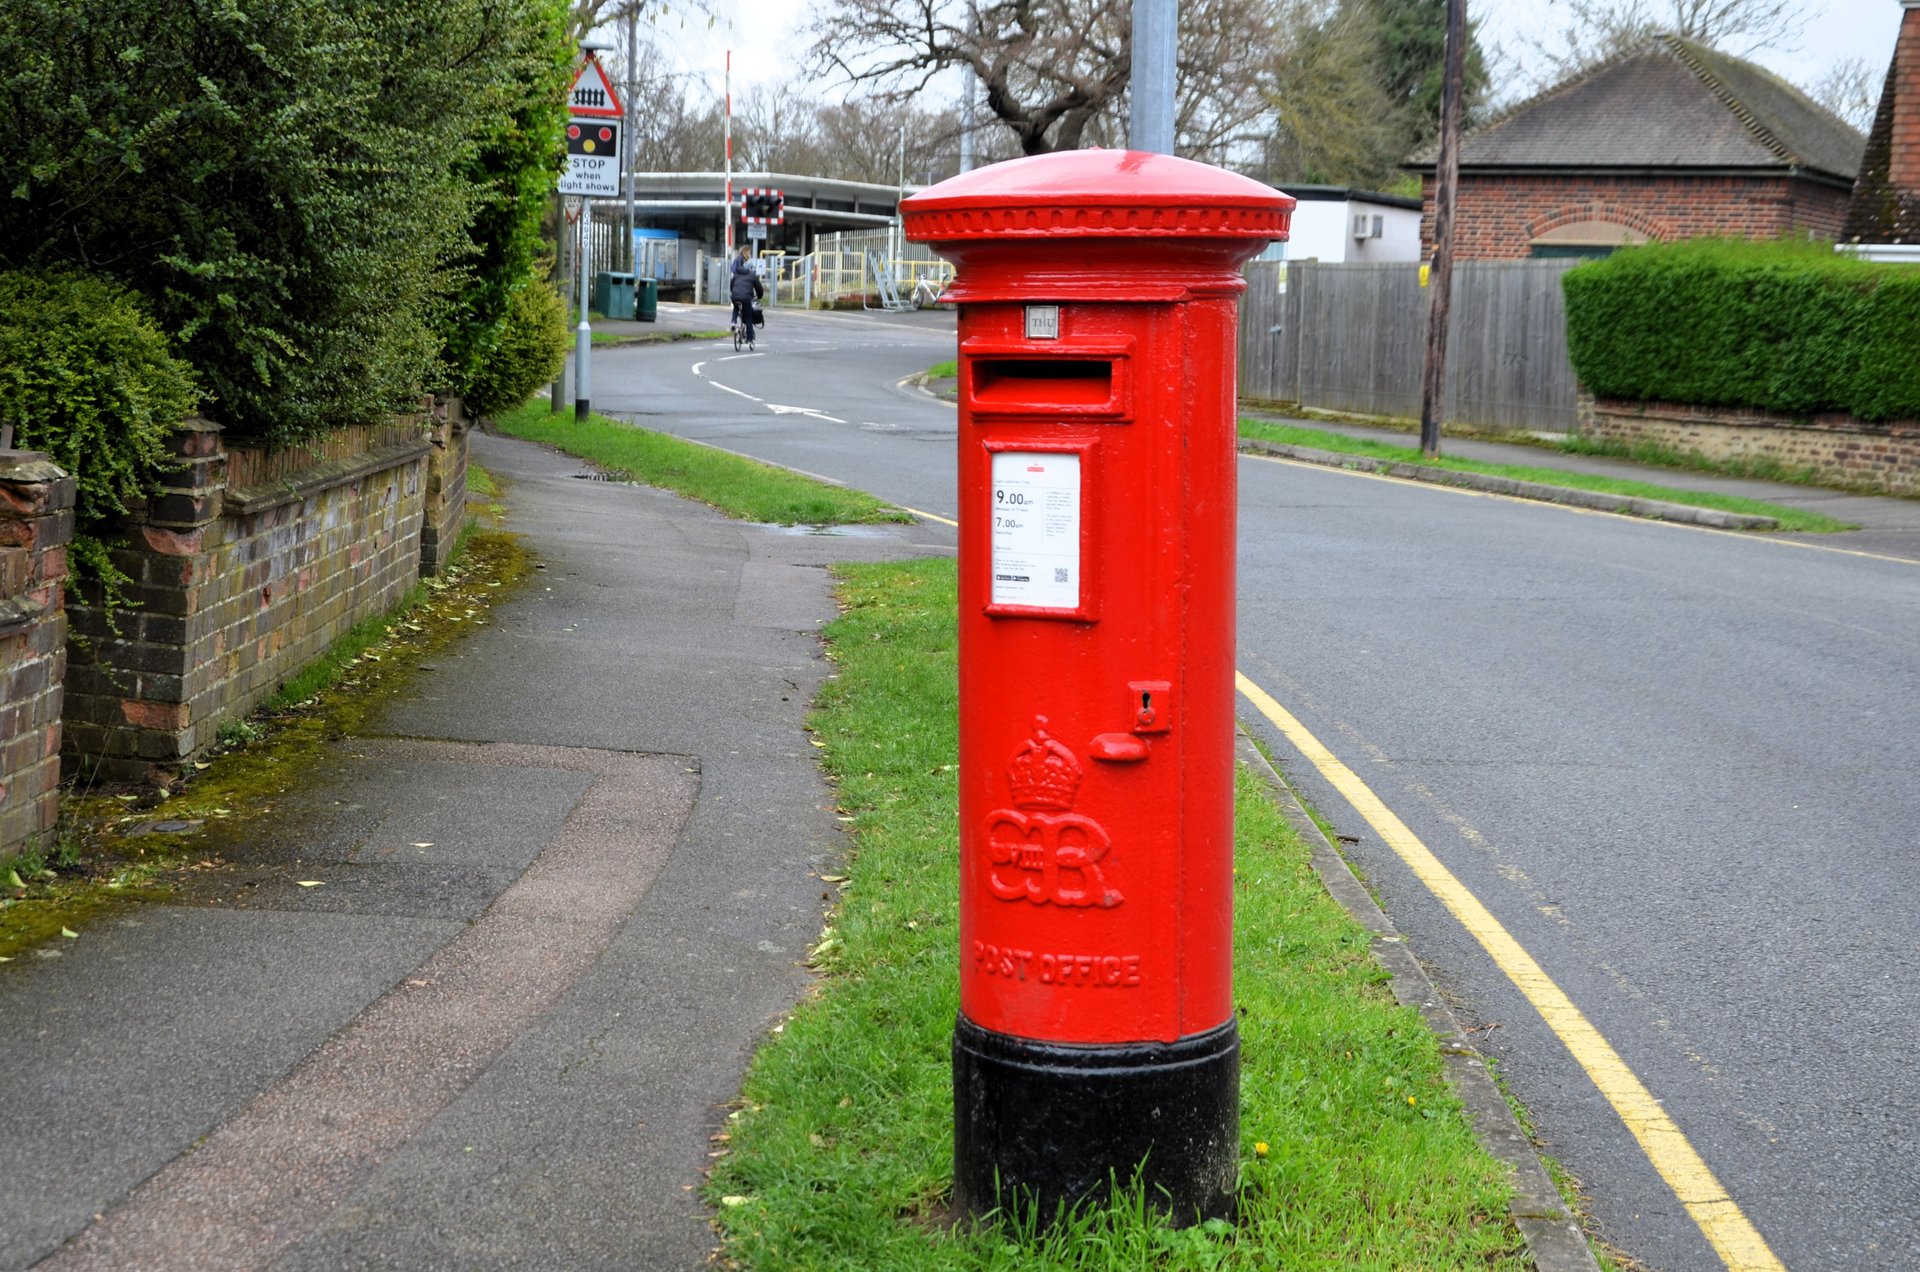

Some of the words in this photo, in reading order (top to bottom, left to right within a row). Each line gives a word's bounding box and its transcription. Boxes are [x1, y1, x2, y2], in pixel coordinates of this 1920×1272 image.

[573, 158, 605, 169] STOP
[575, 171, 601, 180] when
[560, 180, 582, 190] light
[585, 182, 615, 191] shows
[1031, 318, 1056, 328] THU
[974, 939, 1033, 981] POST
[1039, 953, 1141, 987] OFFICE
